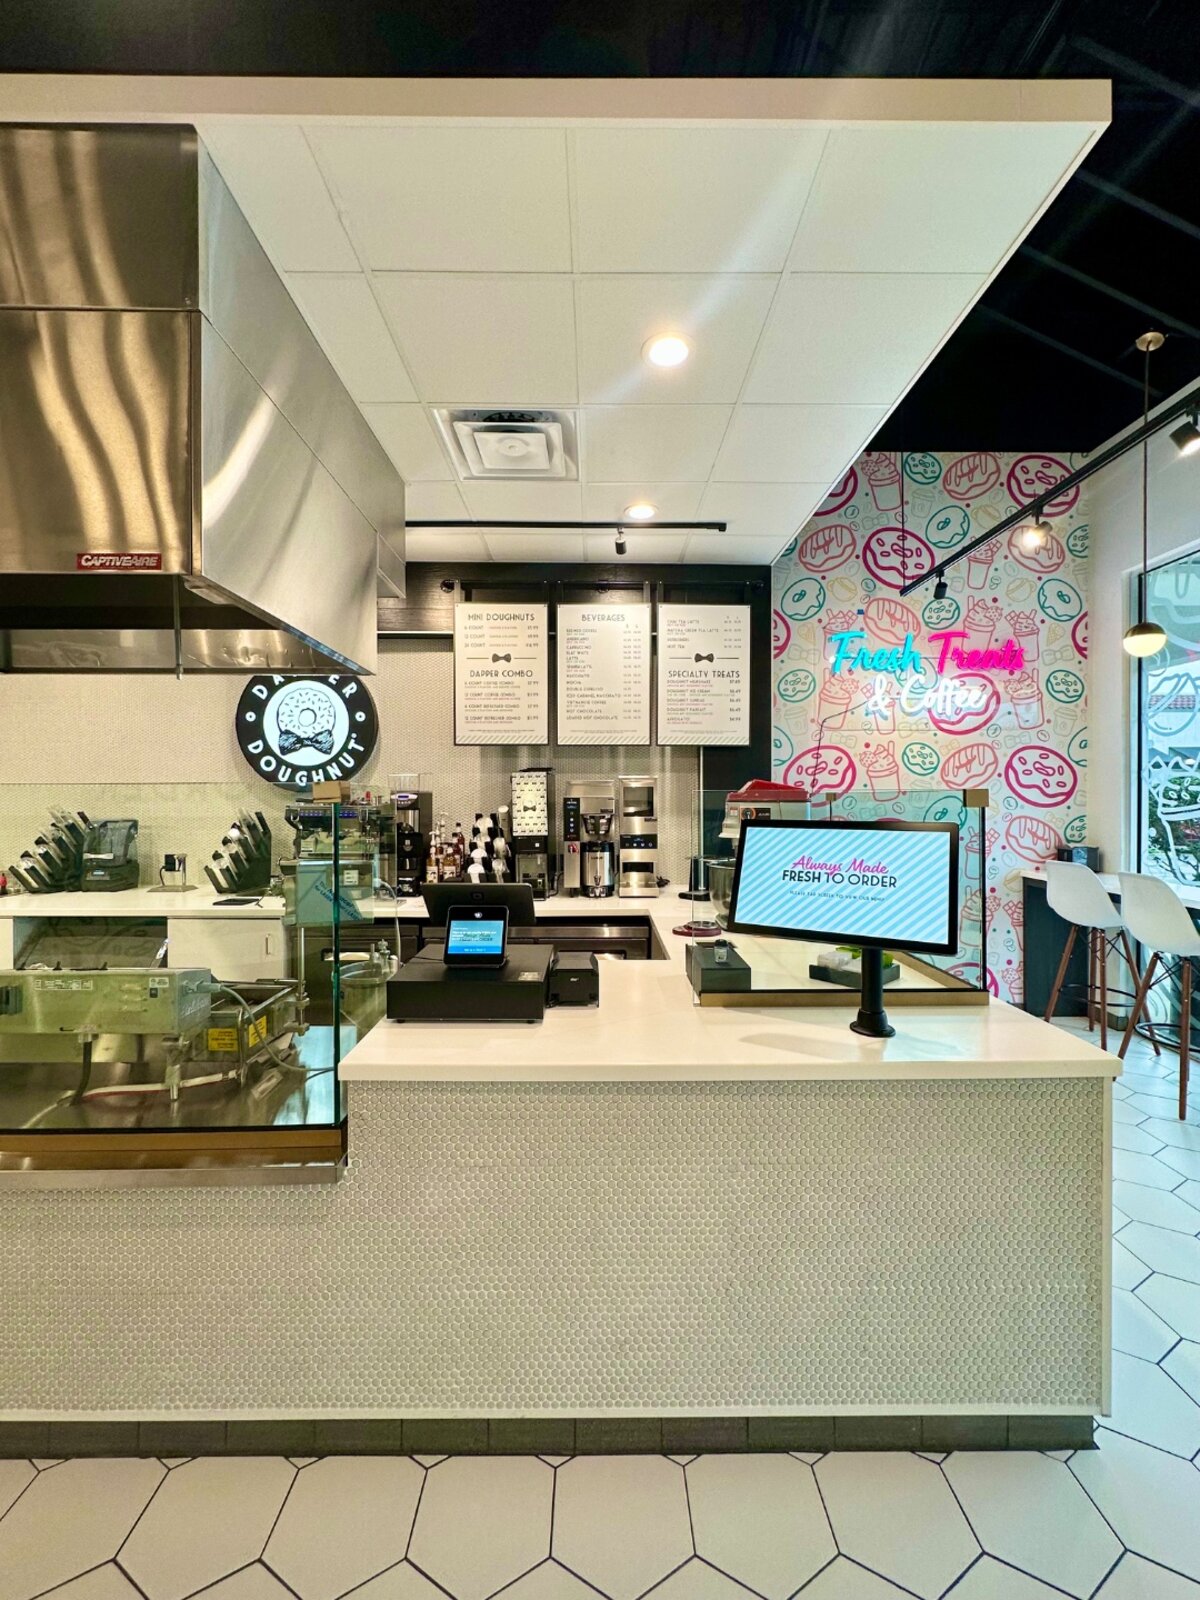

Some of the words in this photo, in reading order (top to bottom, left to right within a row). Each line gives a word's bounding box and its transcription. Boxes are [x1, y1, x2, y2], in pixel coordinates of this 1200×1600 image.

[81, 554, 158, 567] CAPTIVEAIRE
[468, 613, 484, 621] MINI
[486, 613, 535, 621] DOUGHNUTS
[581, 614, 625, 622] BEVERAGES
[831, 630, 926, 676] Fresh
[928, 631, 1025, 675] Treats
[470, 670, 499, 678] DAPPER
[502, 670, 533, 678] COMBO
[252, 674, 358, 700] DAER
[868, 674, 889, 716] &
[900, 674, 988, 716] Coffee
[247, 739, 365, 786] DOUGHNUT
[791, 855, 843, 876] Always
[845, 857, 889, 875] Made
[781, 869, 821, 883] FRESH
[824, 872, 845, 885] TO
[848, 874, 897, 888] ORDER
